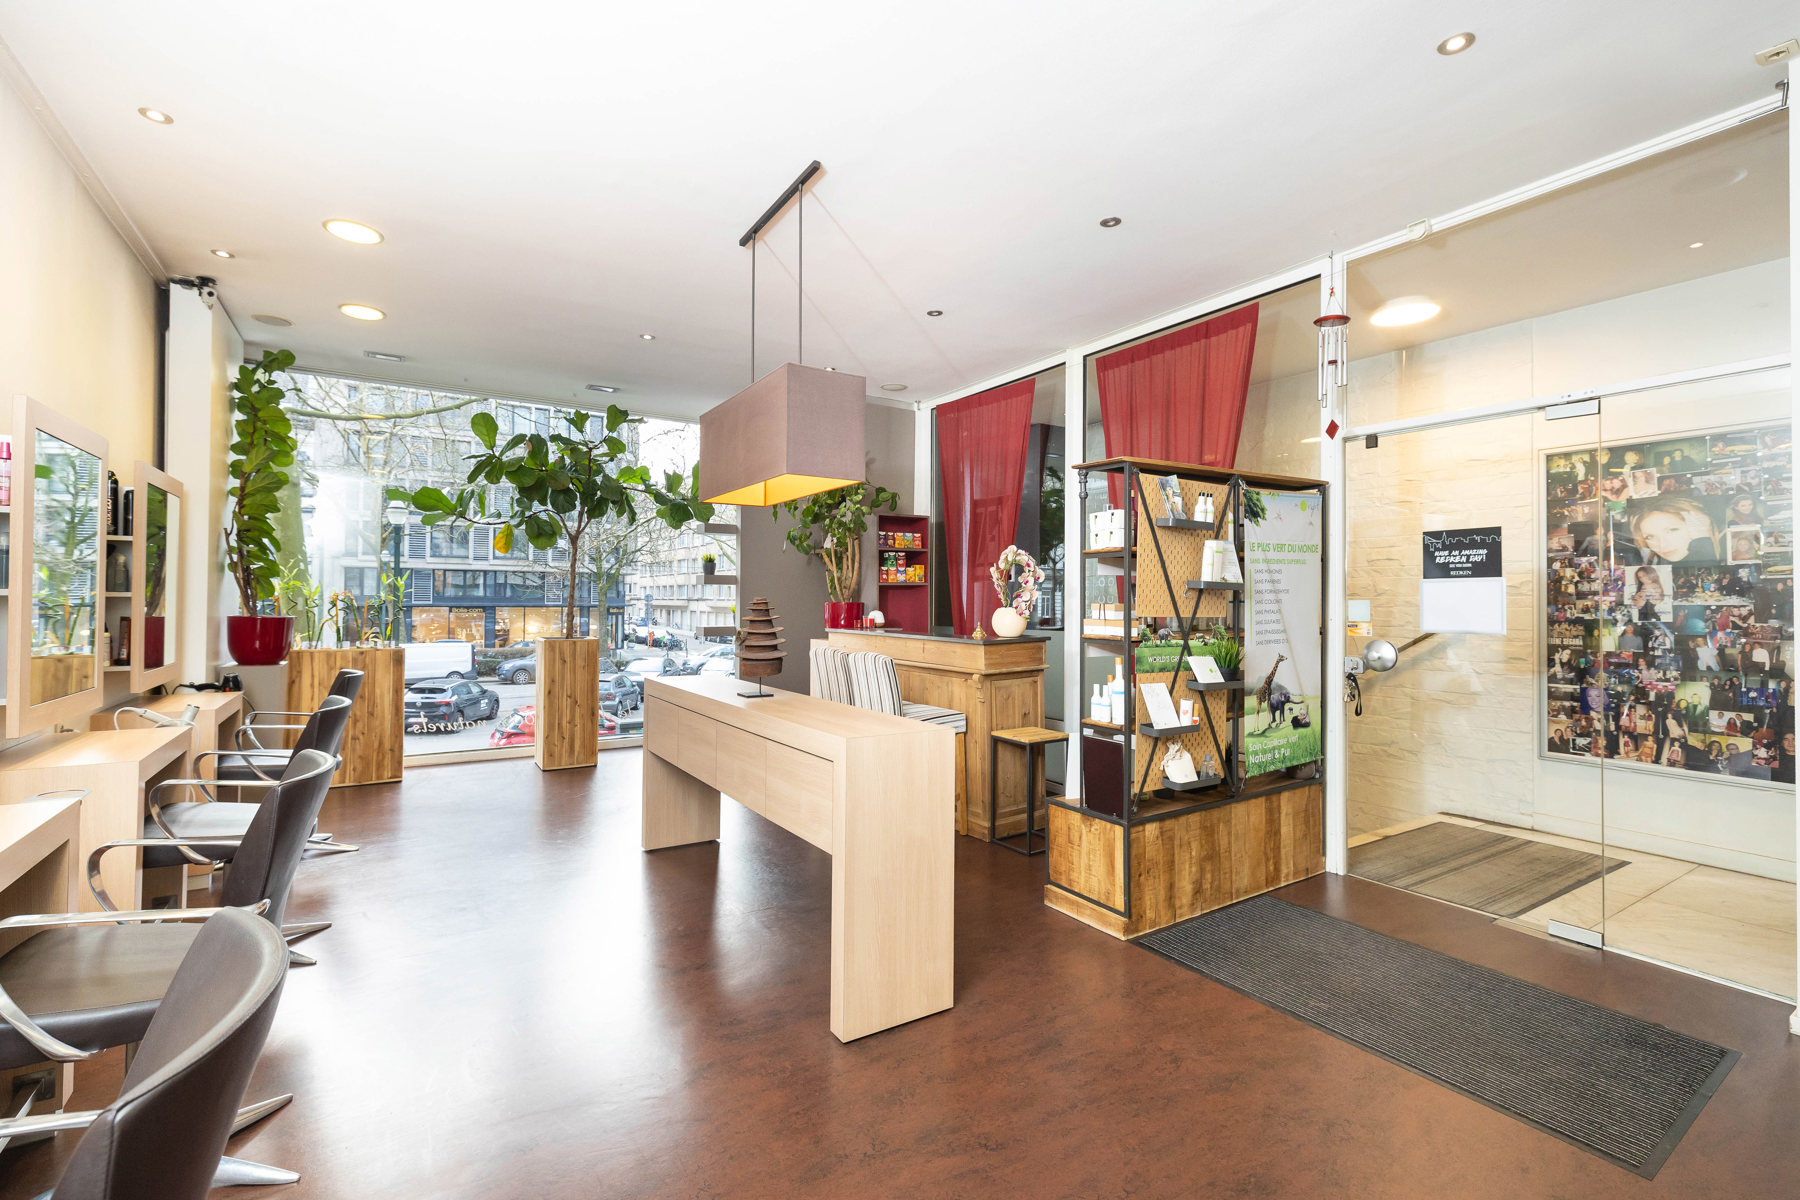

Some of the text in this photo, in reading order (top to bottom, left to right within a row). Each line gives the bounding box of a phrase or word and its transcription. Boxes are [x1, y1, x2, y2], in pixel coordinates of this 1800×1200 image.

[1257, 542, 1271, 552] PLUS
[1272, 544, 1286, 552] VERT
[1288, 544, 1296, 553] DU
[1298, 544, 1319, 553] MONDE
[1249, 750, 1273, 764] Naturel
